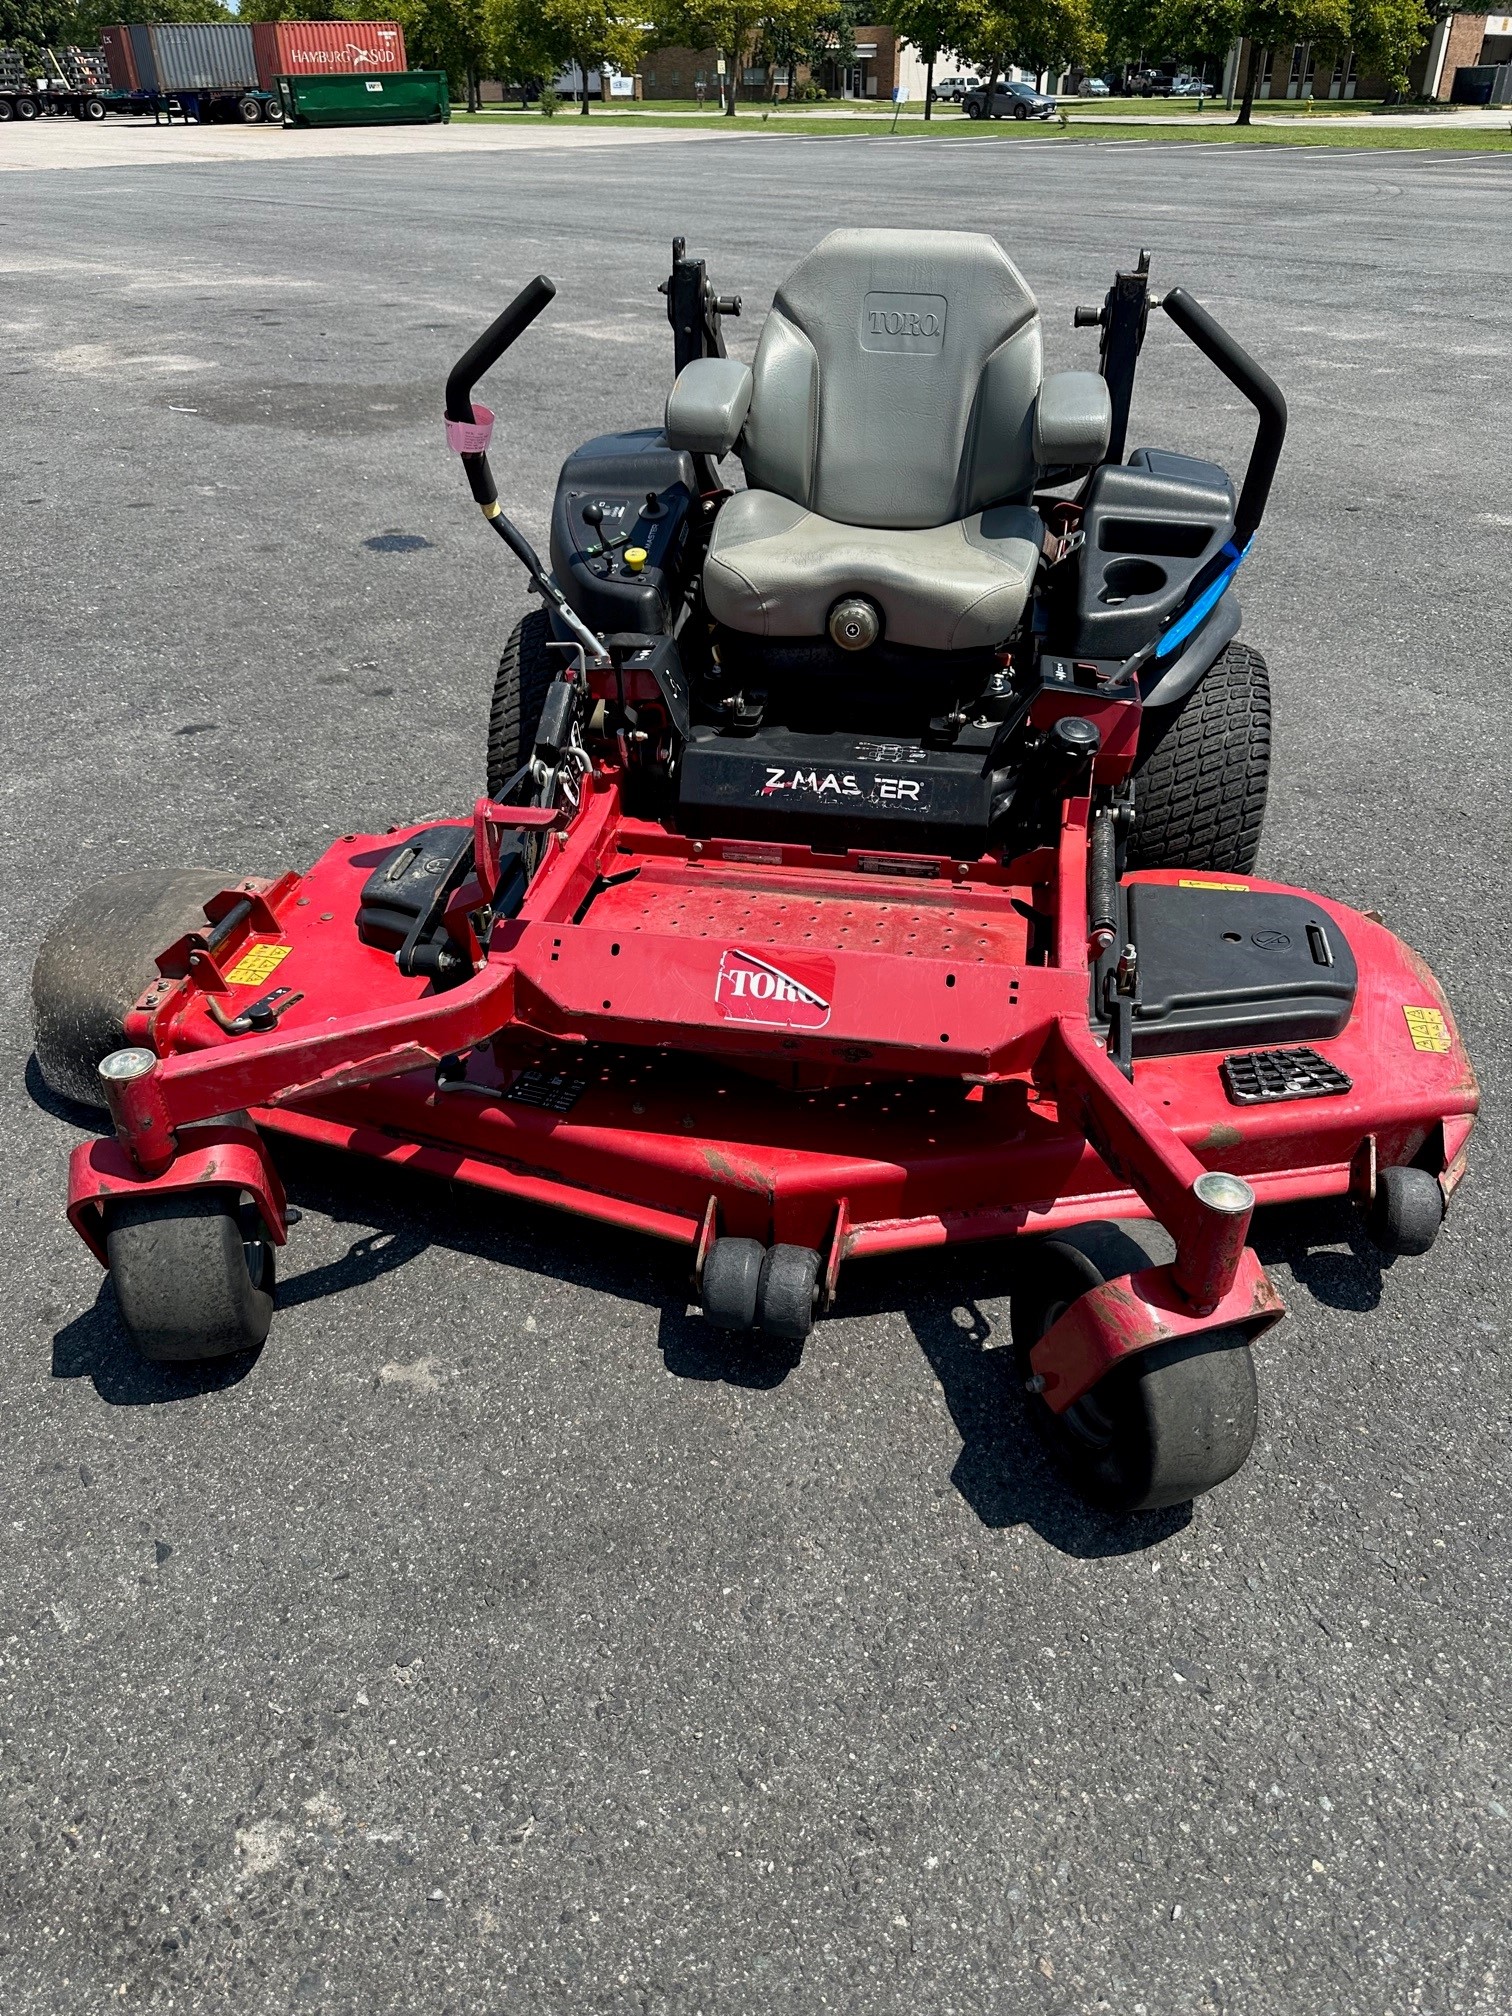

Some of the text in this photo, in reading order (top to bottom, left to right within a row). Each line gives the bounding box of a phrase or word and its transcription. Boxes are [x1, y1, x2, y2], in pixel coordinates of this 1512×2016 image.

[291, 48, 395, 63] HAMBURG SÜD
[868, 310, 939, 337] TORO
[791, 770, 920, 801] MASER
